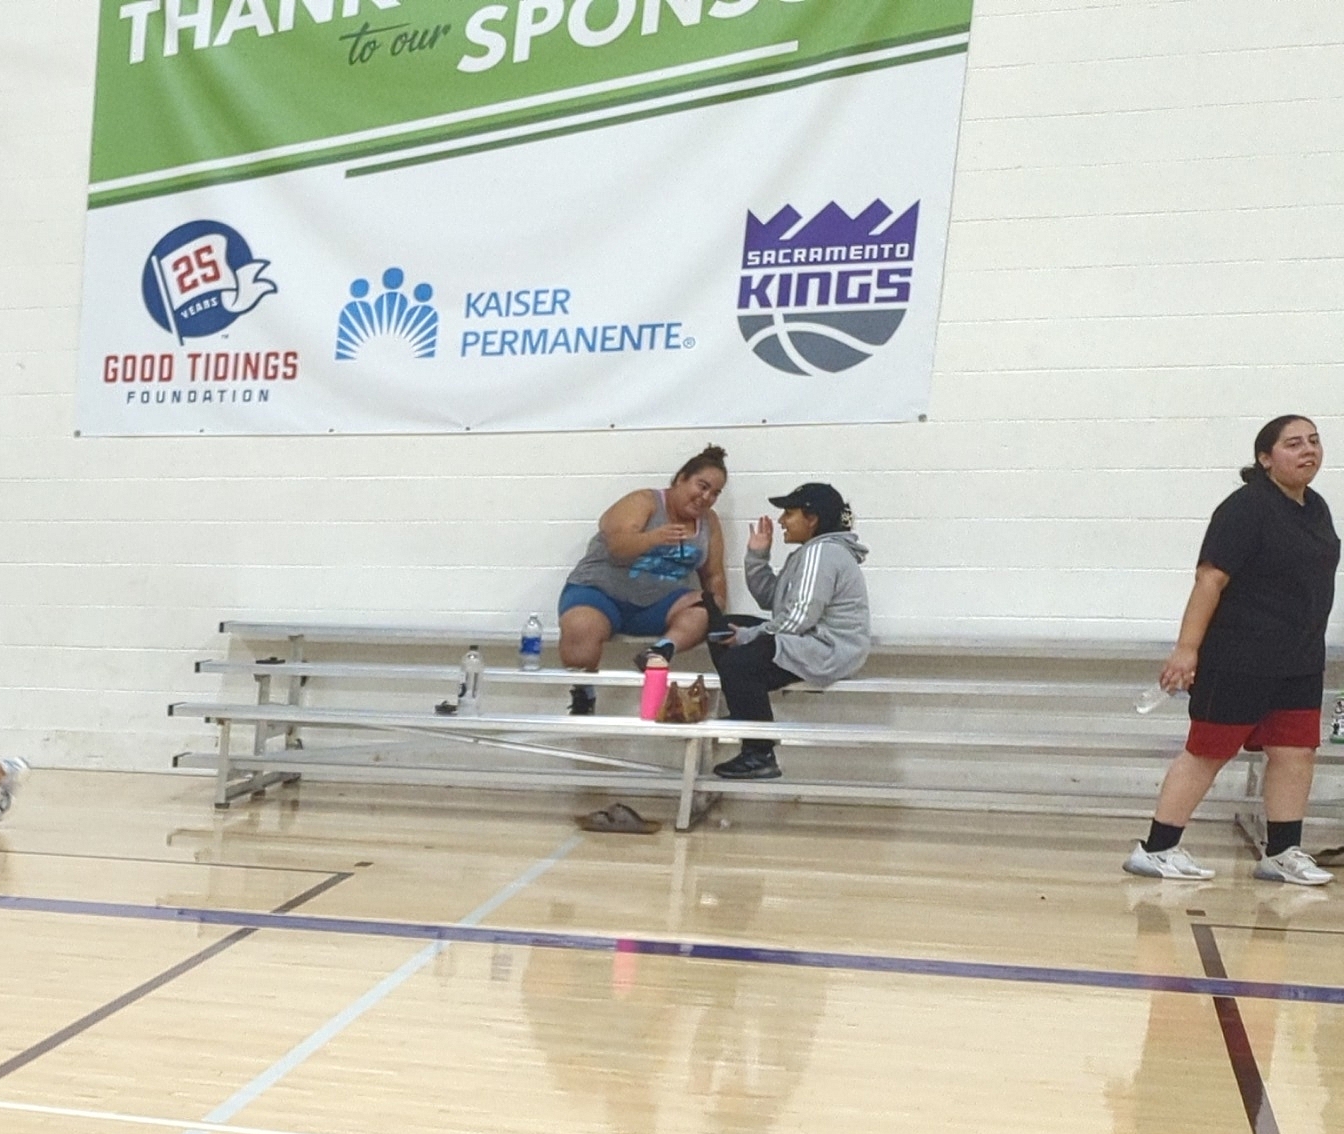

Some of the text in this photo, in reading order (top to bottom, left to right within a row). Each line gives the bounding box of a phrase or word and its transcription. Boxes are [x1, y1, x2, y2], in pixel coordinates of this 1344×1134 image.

[339, 21, 410, 66] to
[390, 23, 452, 57] our
[171, 244, 221, 295] 25
[746, 242, 910, 266] SACRAMENTO
[736, 267, 913, 309] KINGS
[180, 296, 220, 319] YEARS
[464, 289, 572, 319] KAISER
[103, 351, 299, 383] GOOD TIDINGS
[126, 388, 270, 405] FOUNDATION
